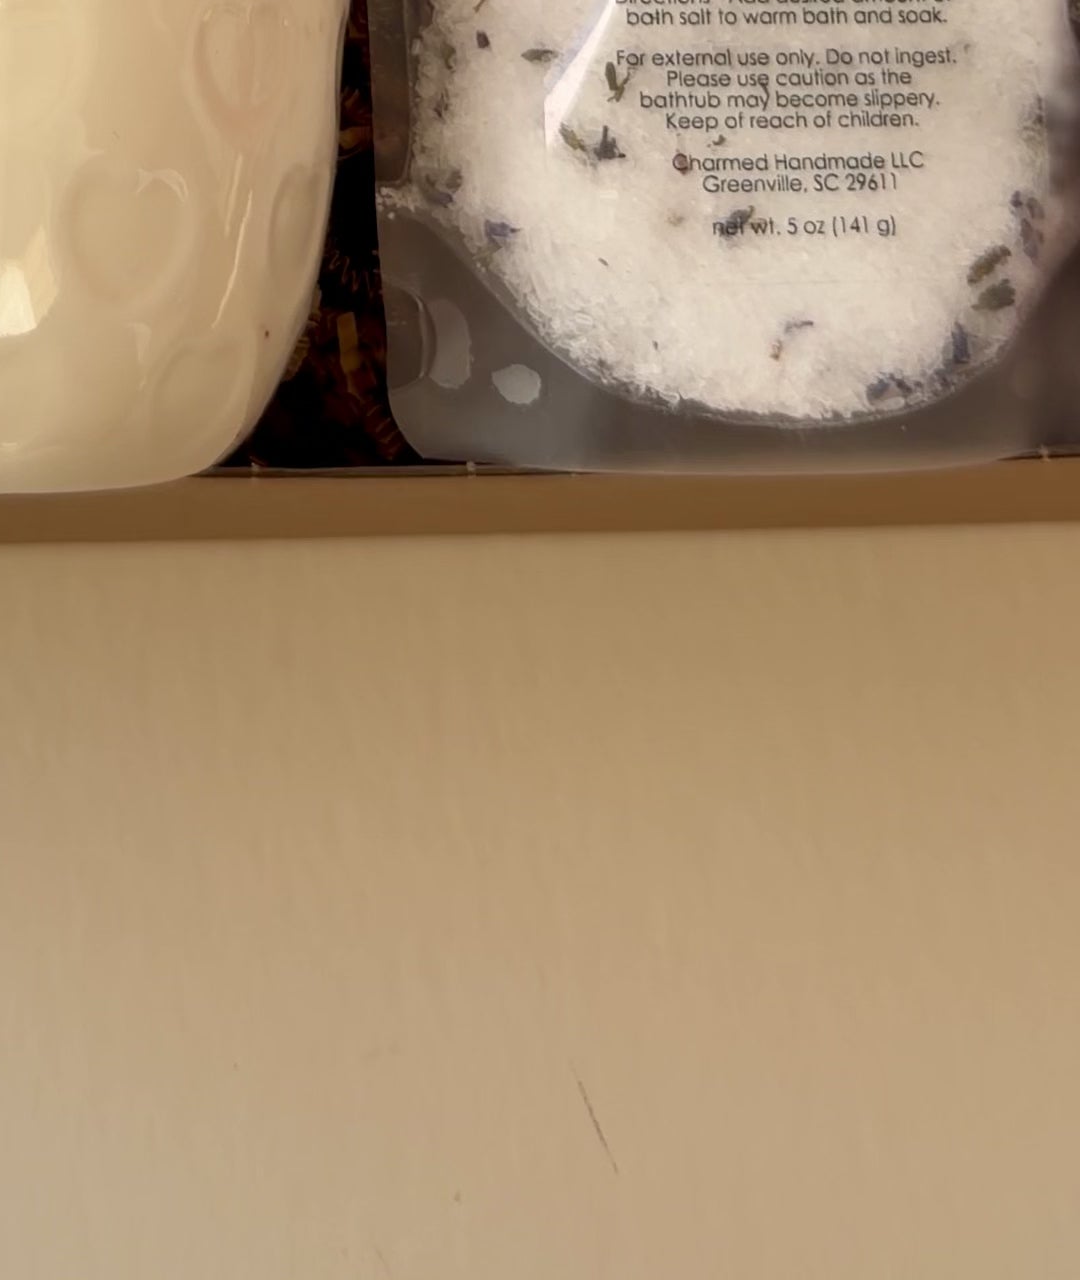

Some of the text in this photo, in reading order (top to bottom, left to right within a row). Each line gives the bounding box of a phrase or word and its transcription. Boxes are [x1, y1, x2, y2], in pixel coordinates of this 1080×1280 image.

[626, 6, 948, 25] bath salt to warm bath and soak.
[616, 48, 958, 69] For external use only. Do not ingest.
[667, 69, 912, 87] Please use caution as the
[639, 90, 941, 112] bathtub may become slippery.
[665, 110, 920, 132] Keep of reach of children.
[672, 151, 925, 172] Charmed Handmade LLC
[813, 174, 840, 192] SC
[845, 172, 897, 190] 29611
[712, 216, 897, 237] net wt. 5 oz (141 g)
